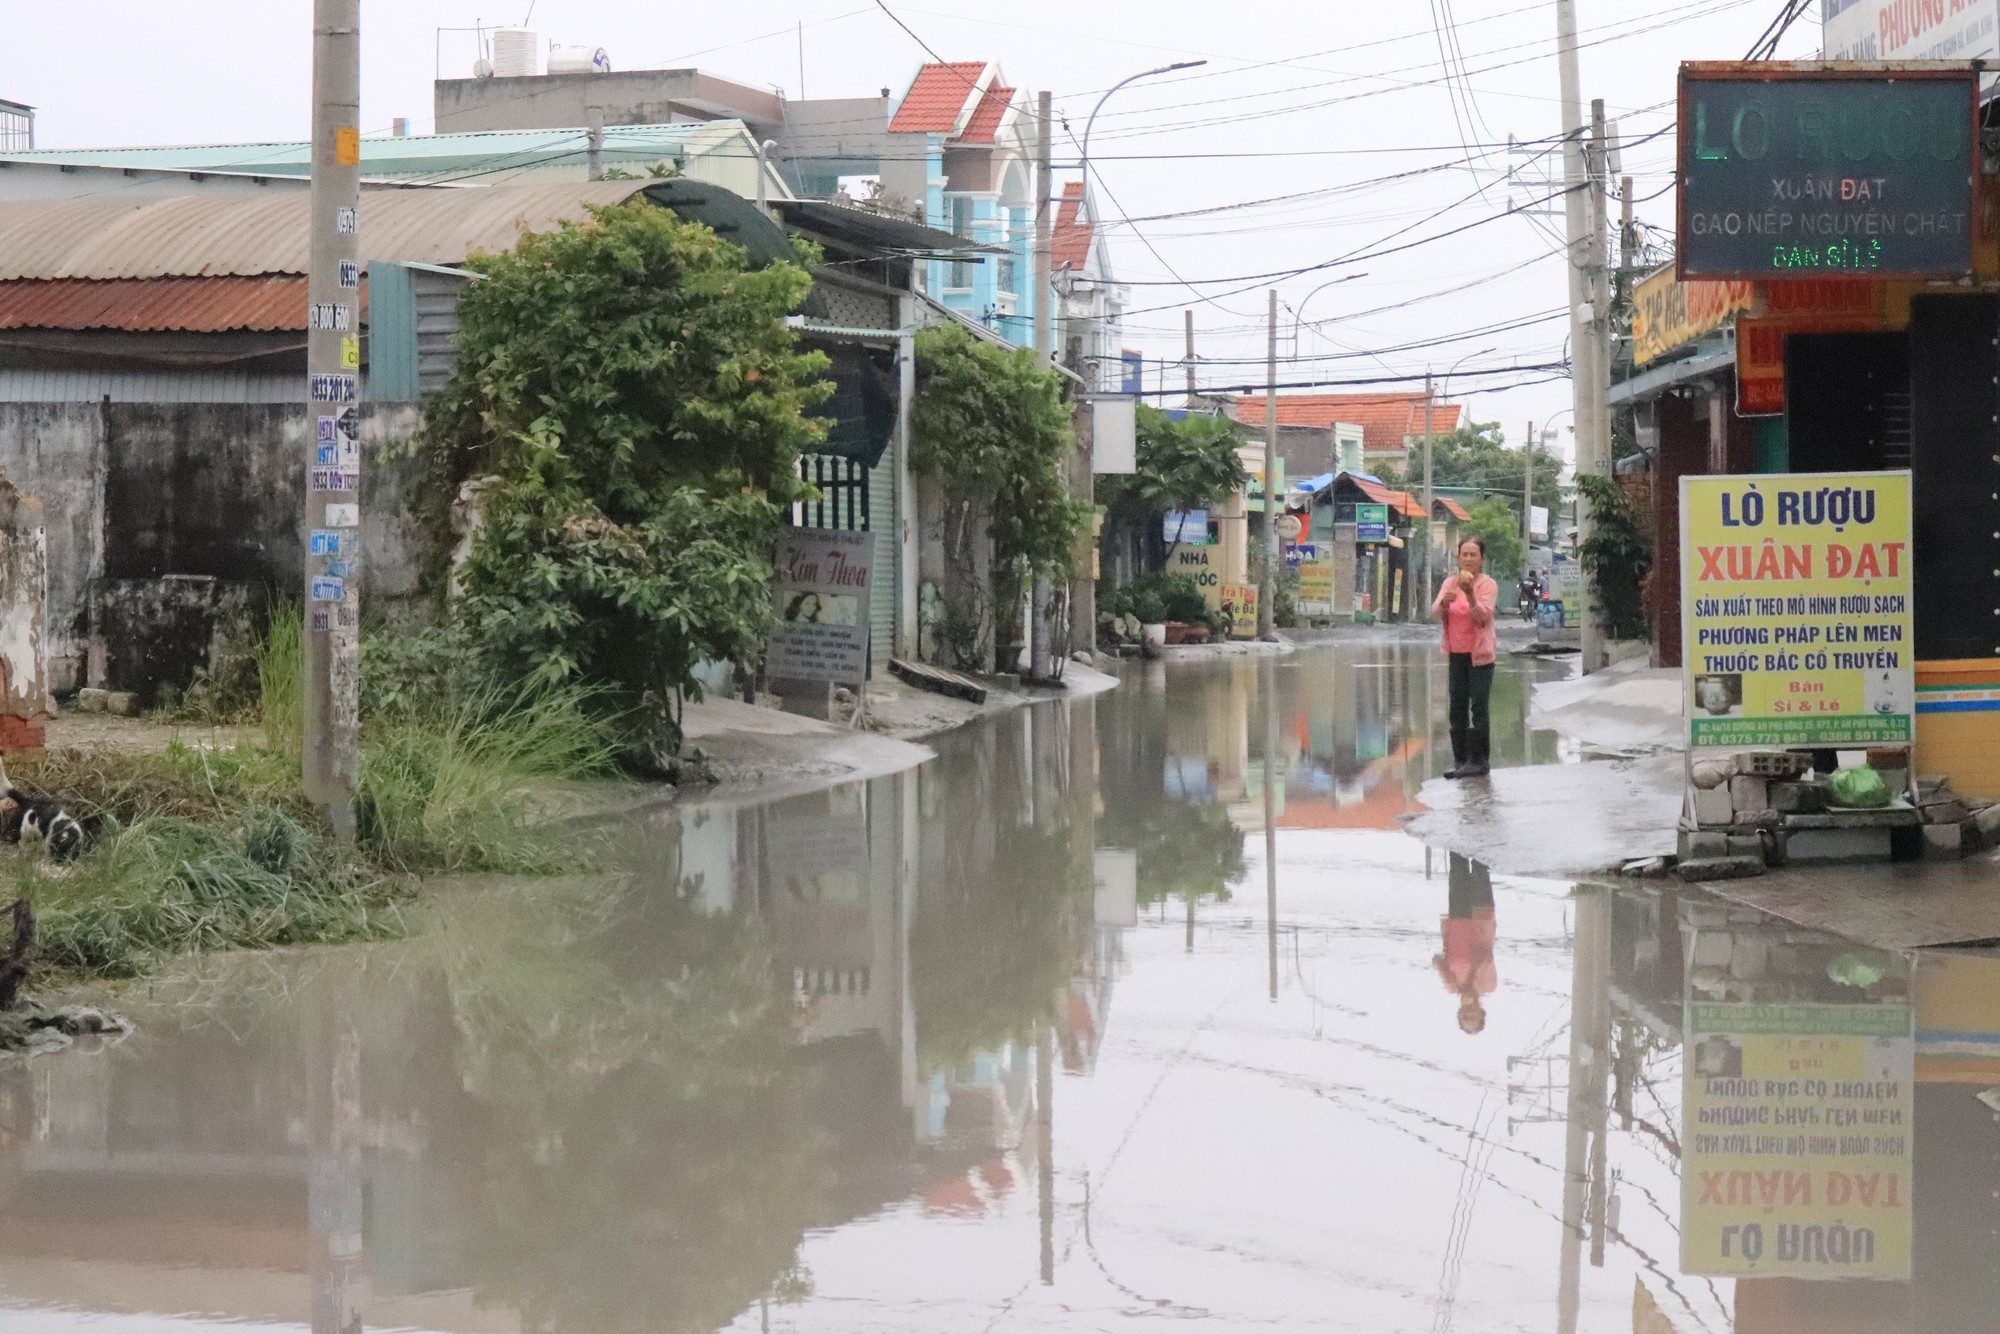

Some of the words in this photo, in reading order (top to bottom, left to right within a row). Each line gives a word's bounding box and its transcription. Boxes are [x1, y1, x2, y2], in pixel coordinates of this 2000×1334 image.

[1772, 173, 1833, 199] XUÂN
[1840, 178, 1885, 204] ĐẠT
[1722, 483, 1763, 526] LÒ
[1778, 487, 1875, 532] RƯỢU
[1180, 549, 1208, 565] NHÀ
[1697, 537, 1812, 581] XUÂN
[1826, 543, 1905, 587] ĐẠT
[1696, 593, 1719, 617] SẢN
[1723, 592, 1752, 616] XUẤT
[1755, 598, 1783, 616] THEO
[1787, 594, 1805, 615] MÔ
[1840, 595, 1870, 618] RƯỢU
[1874, 595, 1905, 617] SẠCH
[1699, 627, 1768, 645] PHƯƠNG
[1775, 623, 1819, 643] PHÁP
[1826, 623, 1857, 642] LÊN
[1863, 625, 1902, 642] MEN
[1704, 649, 1759, 672] THUỐC
[1765, 648, 1798, 671] BẮC
[1805, 647, 1827, 670] CỔ
[1789, 681, 1824, 692] Bán
[1799, 701, 1812, 711] &
